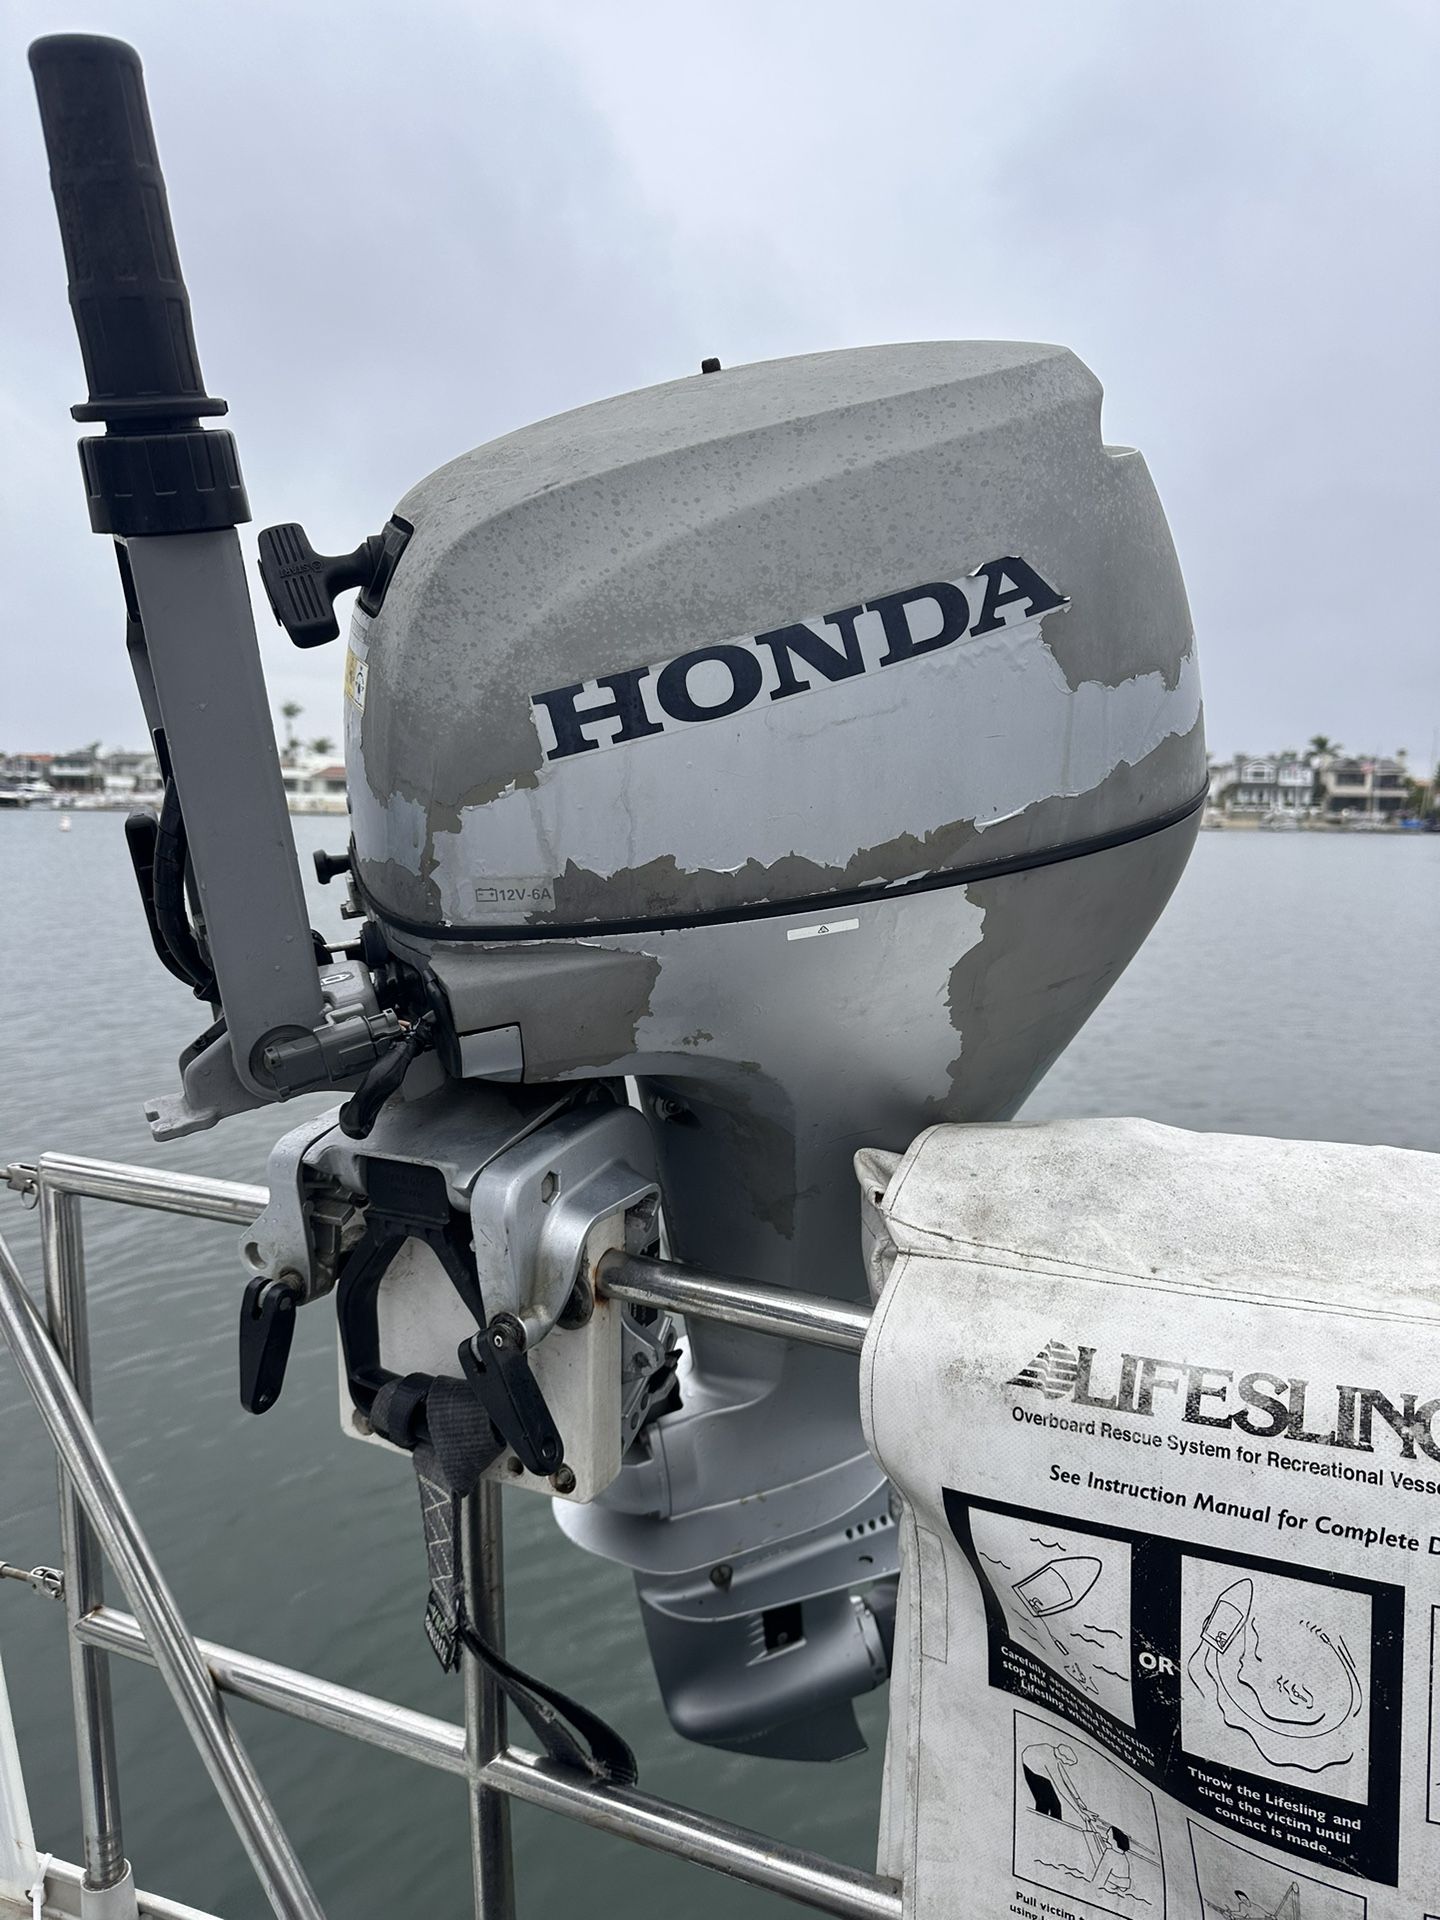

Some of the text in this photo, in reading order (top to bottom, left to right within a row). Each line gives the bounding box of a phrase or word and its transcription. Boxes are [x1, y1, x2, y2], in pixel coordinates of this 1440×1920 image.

[531, 556, 1071, 762] HONDA
[499, 888, 552, 901] 12V-6A
[1012, 1406, 1440, 1495] Overboard Rescue System for Recreational Vess
[1050, 1464, 1081, 1485] See
[1087, 1471, 1187, 1506] Instruction
[1193, 1492, 1271, 1523] Manual
[1277, 1508, 1308, 1530] for
[1315, 1516, 1420, 1551] Complete
[1001, 1645, 1046, 1678] Carefully
[1096, 1711, 1113, 1729] the
[1116, 1726, 1155, 1758] victim,
[1138, 1651, 1175, 1676] OR
[1002, 1660, 1156, 1767] stop the vessel and throw the
[1021, 1679, 1140, 1767] Lifesling when close by.
[1187, 1765, 1362, 1831] Throw the Lifesling and
[1198, 1784, 1351, 1845] circle the victim until
[1215, 1806, 1332, 1856] contact is made.
[1015, 1890, 1076, 1920] Pull victim
